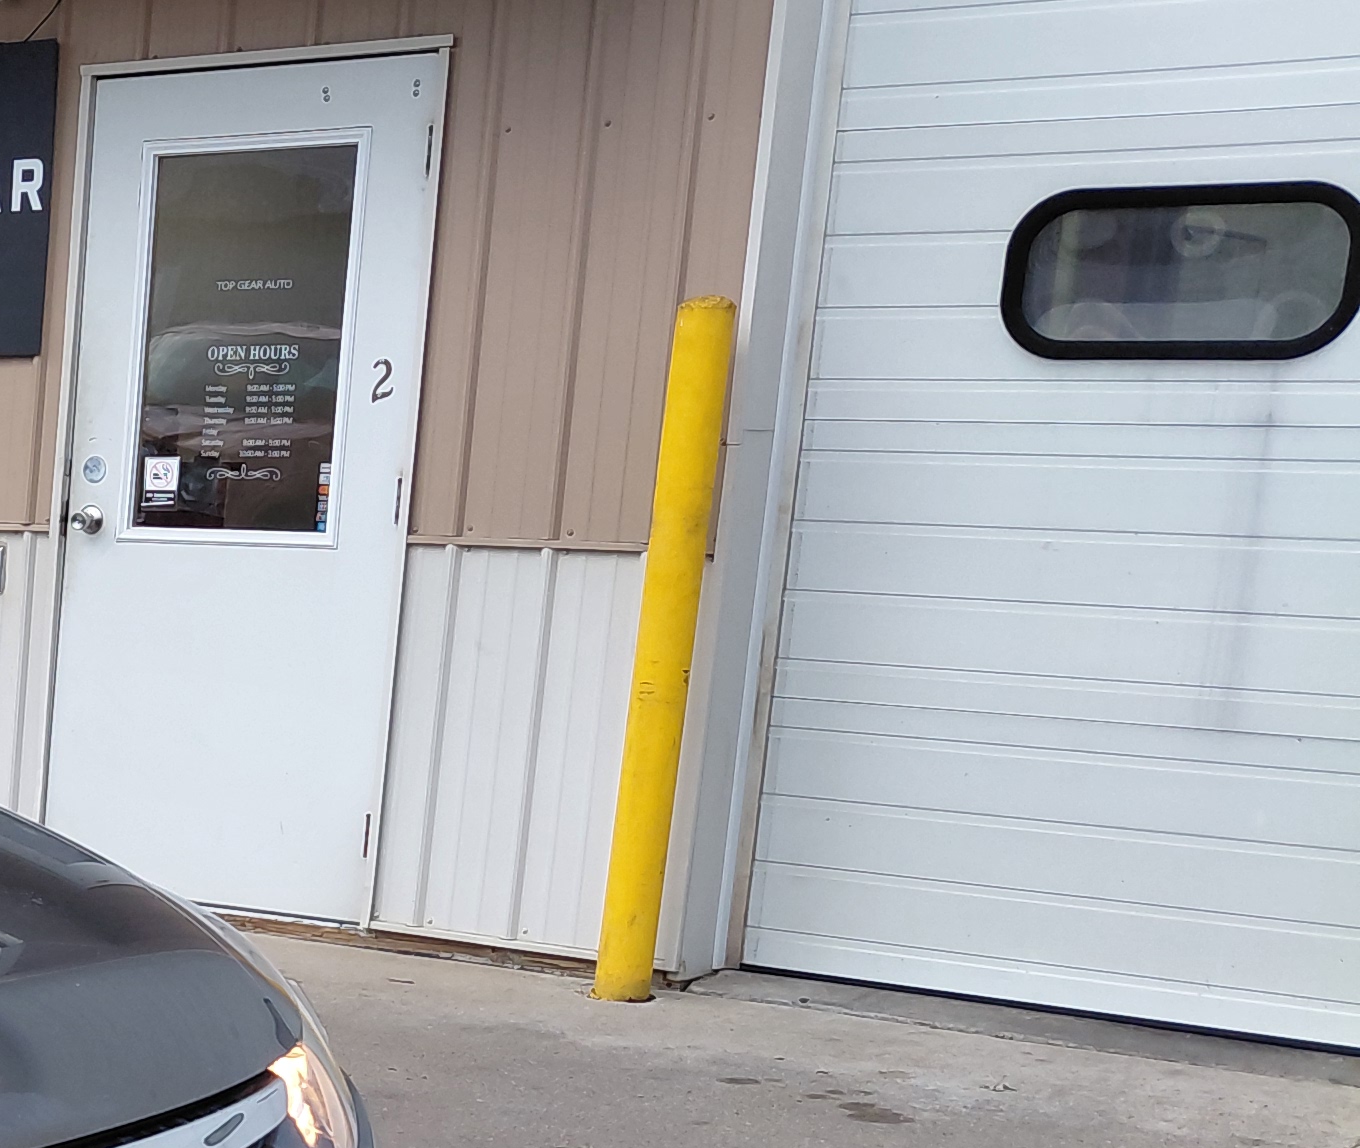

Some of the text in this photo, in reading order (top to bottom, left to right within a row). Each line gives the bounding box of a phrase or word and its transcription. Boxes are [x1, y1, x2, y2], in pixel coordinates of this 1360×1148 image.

[216, 280, 292, 290] TOP GEAR AUTO
[208, 344, 299, 360] OPEN HOURS
[372, 358, 393, 403] 2
